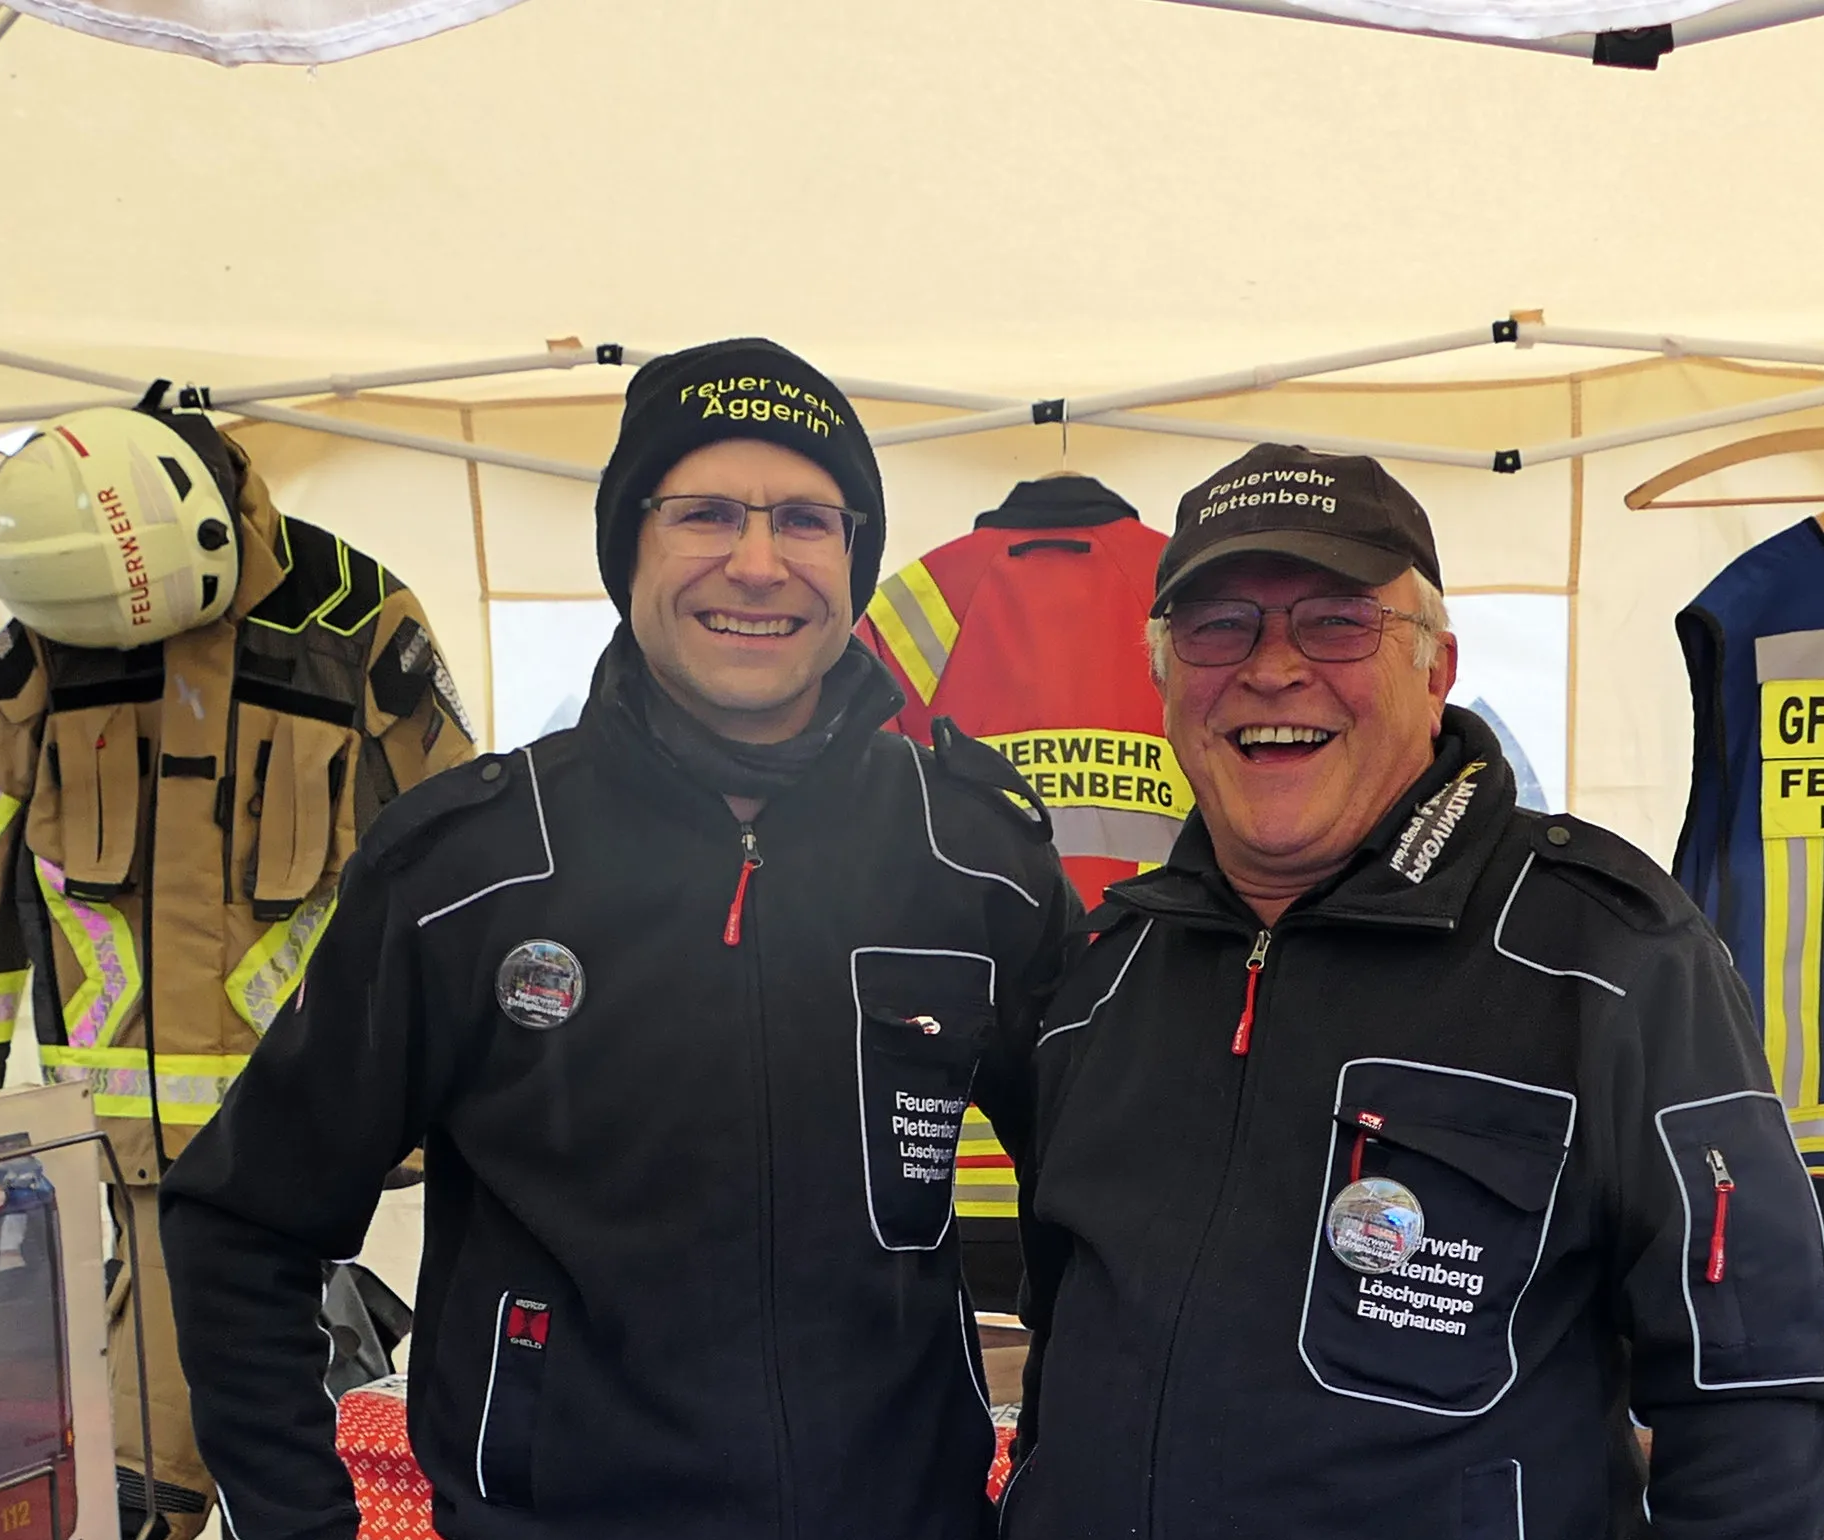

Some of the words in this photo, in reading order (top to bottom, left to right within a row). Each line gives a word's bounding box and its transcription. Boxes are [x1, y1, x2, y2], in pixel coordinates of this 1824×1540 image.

[680, 376, 845, 426] Feuerwehr
[702, 394, 829, 438] Äggerin
[1208, 469, 1335, 500] Feuerwehr
[1199, 488, 1337, 525] Plettenberg
[97, 486, 152, 626] FEUERWEHR
[997, 737, 1162, 772] ERWEHR
[1026, 771, 1173, 808] ENBERG
[1417, 1236, 1484, 1262] rwehr
[1359, 1276, 1474, 1315] Löschgruppe
[1357, 1299, 1467, 1336] Eiringhausen
[389, 1442, 408, 1459] 112
[354, 1459, 370, 1475] 112
[395, 1461, 411, 1476] 112
[370, 1477, 389, 1496] 112
[392, 1478, 409, 1496] 112
[412, 1479, 430, 1496] 112
[1, 1499, 31, 1532] 112
[375, 1498, 393, 1514] 112
[396, 1498, 414, 1516] 112
[371, 1516, 389, 1533] 112
[392, 1517, 410, 1534] 112
[412, 1519, 431, 1535] 112
